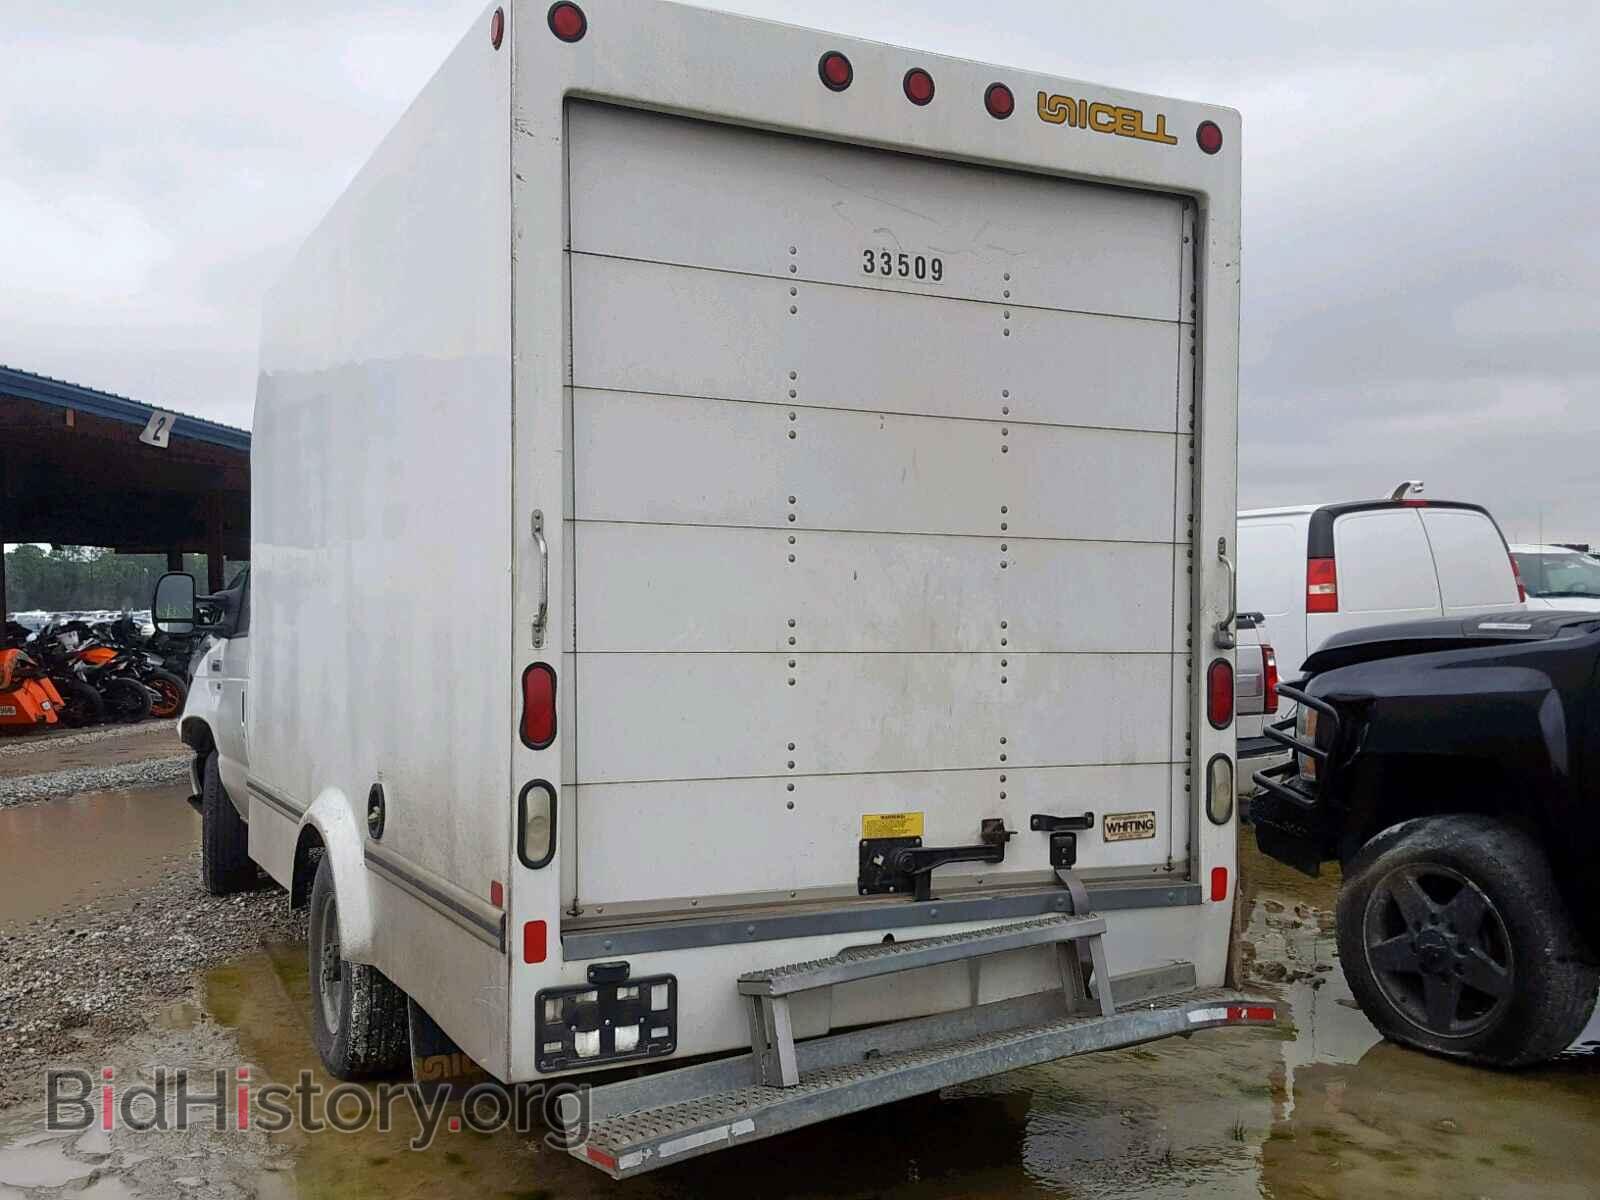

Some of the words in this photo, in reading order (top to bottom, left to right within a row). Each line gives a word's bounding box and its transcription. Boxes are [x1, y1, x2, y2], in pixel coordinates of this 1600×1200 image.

[1036, 90, 1178, 146] UNICELL
[862, 249, 943, 282] 33509
[152, 415, 167, 442] 2
[1106, 819, 1154, 833] WHITING
